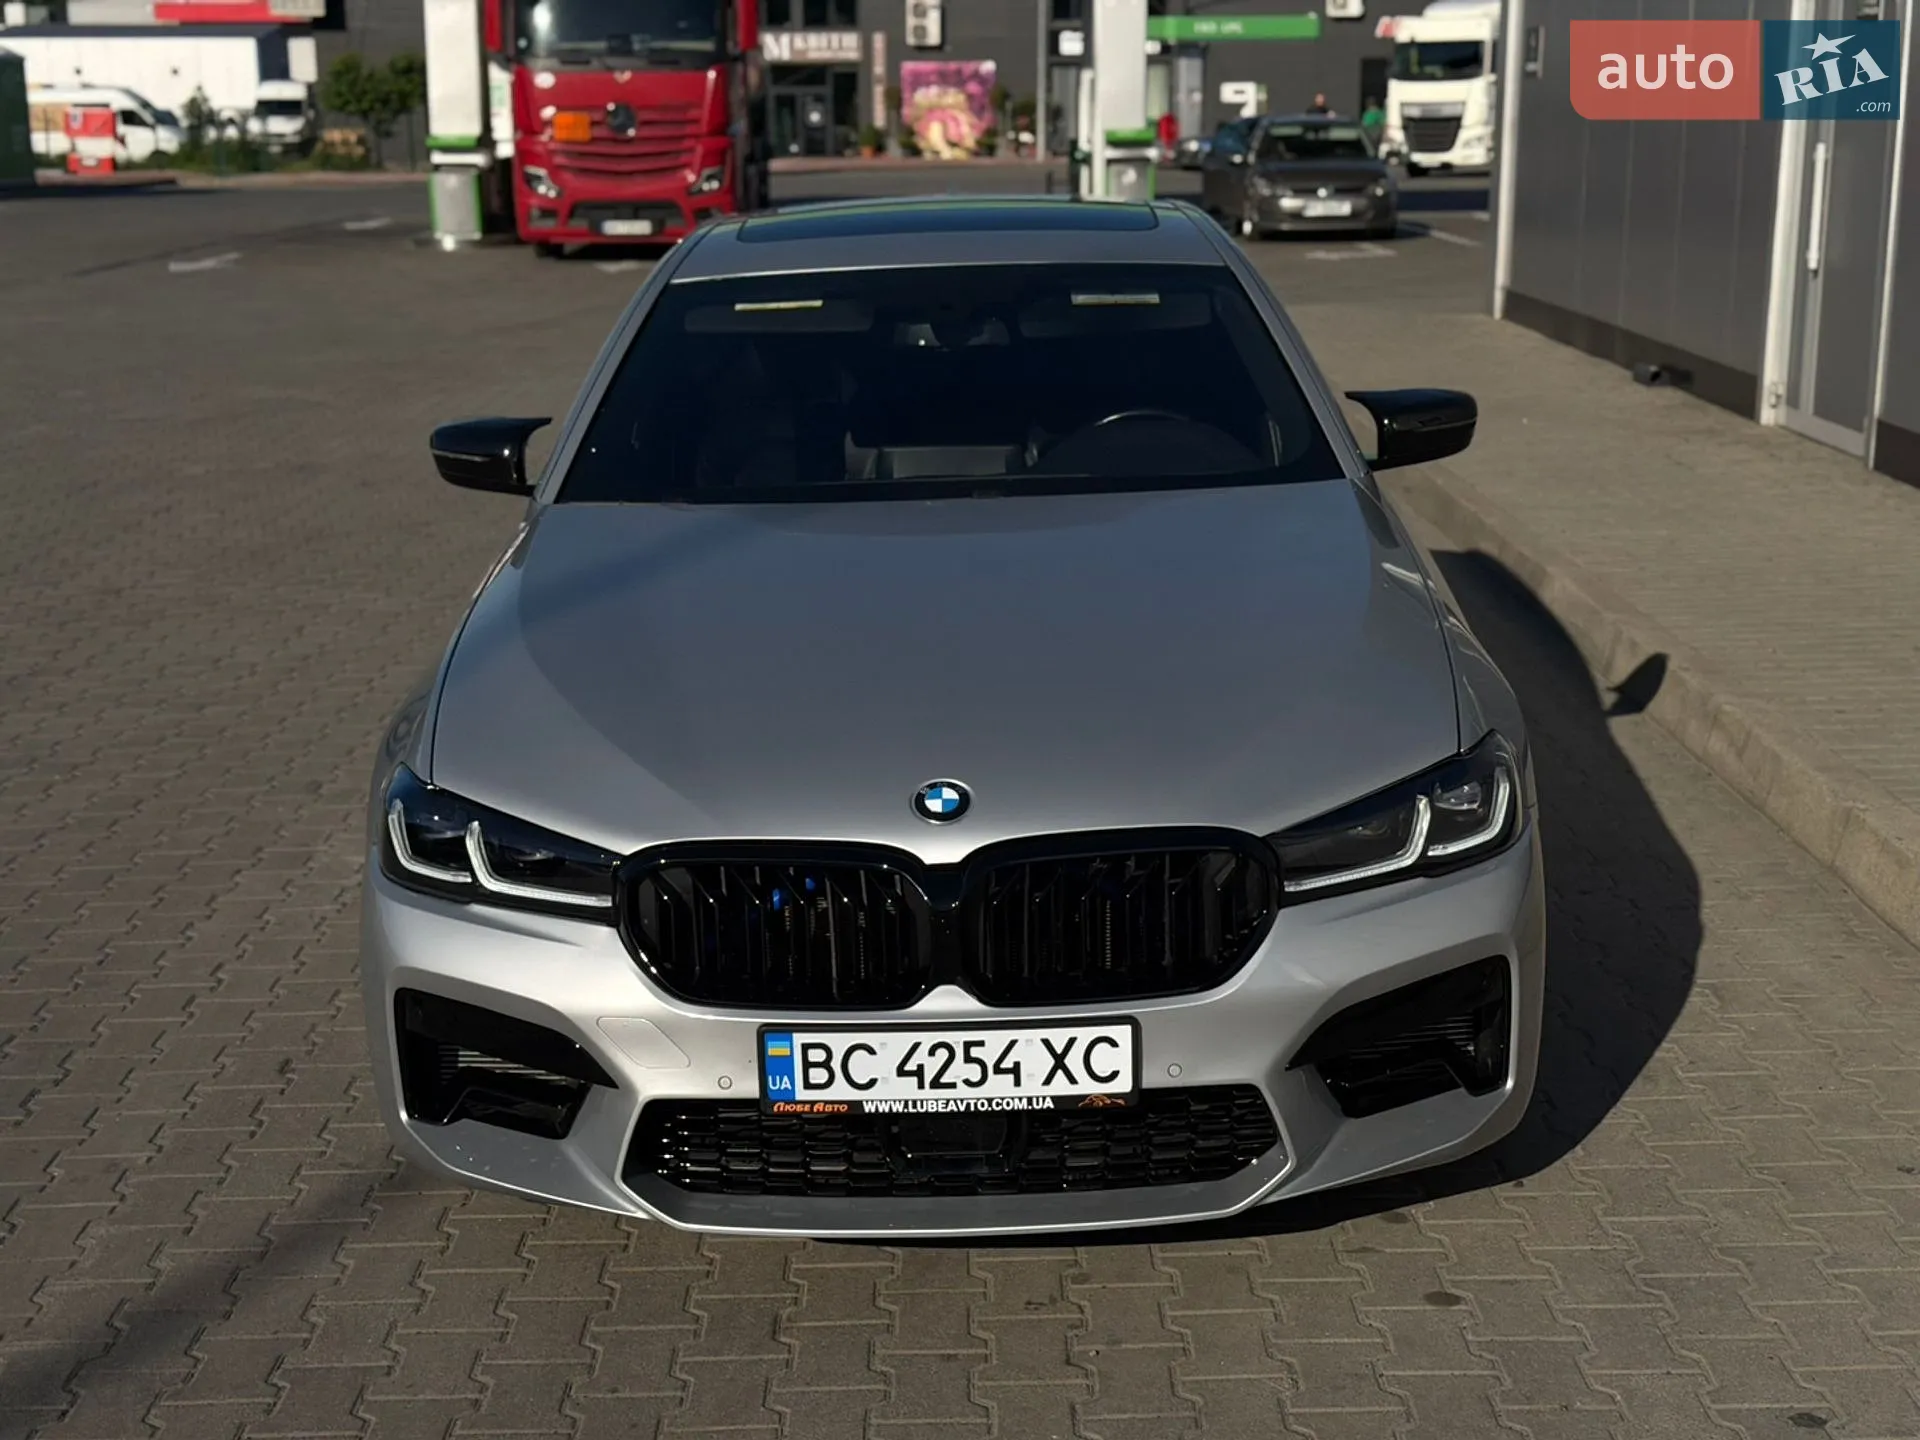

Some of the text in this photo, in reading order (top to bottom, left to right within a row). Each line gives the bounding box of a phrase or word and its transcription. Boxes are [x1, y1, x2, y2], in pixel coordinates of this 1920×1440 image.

[801, 1035, 1121, 1091] BC 4254 XC
[768, 1075, 792, 1091] UA
[862, 1096, 1054, 1113] WWW.LUBEAVTO.COM.UA
